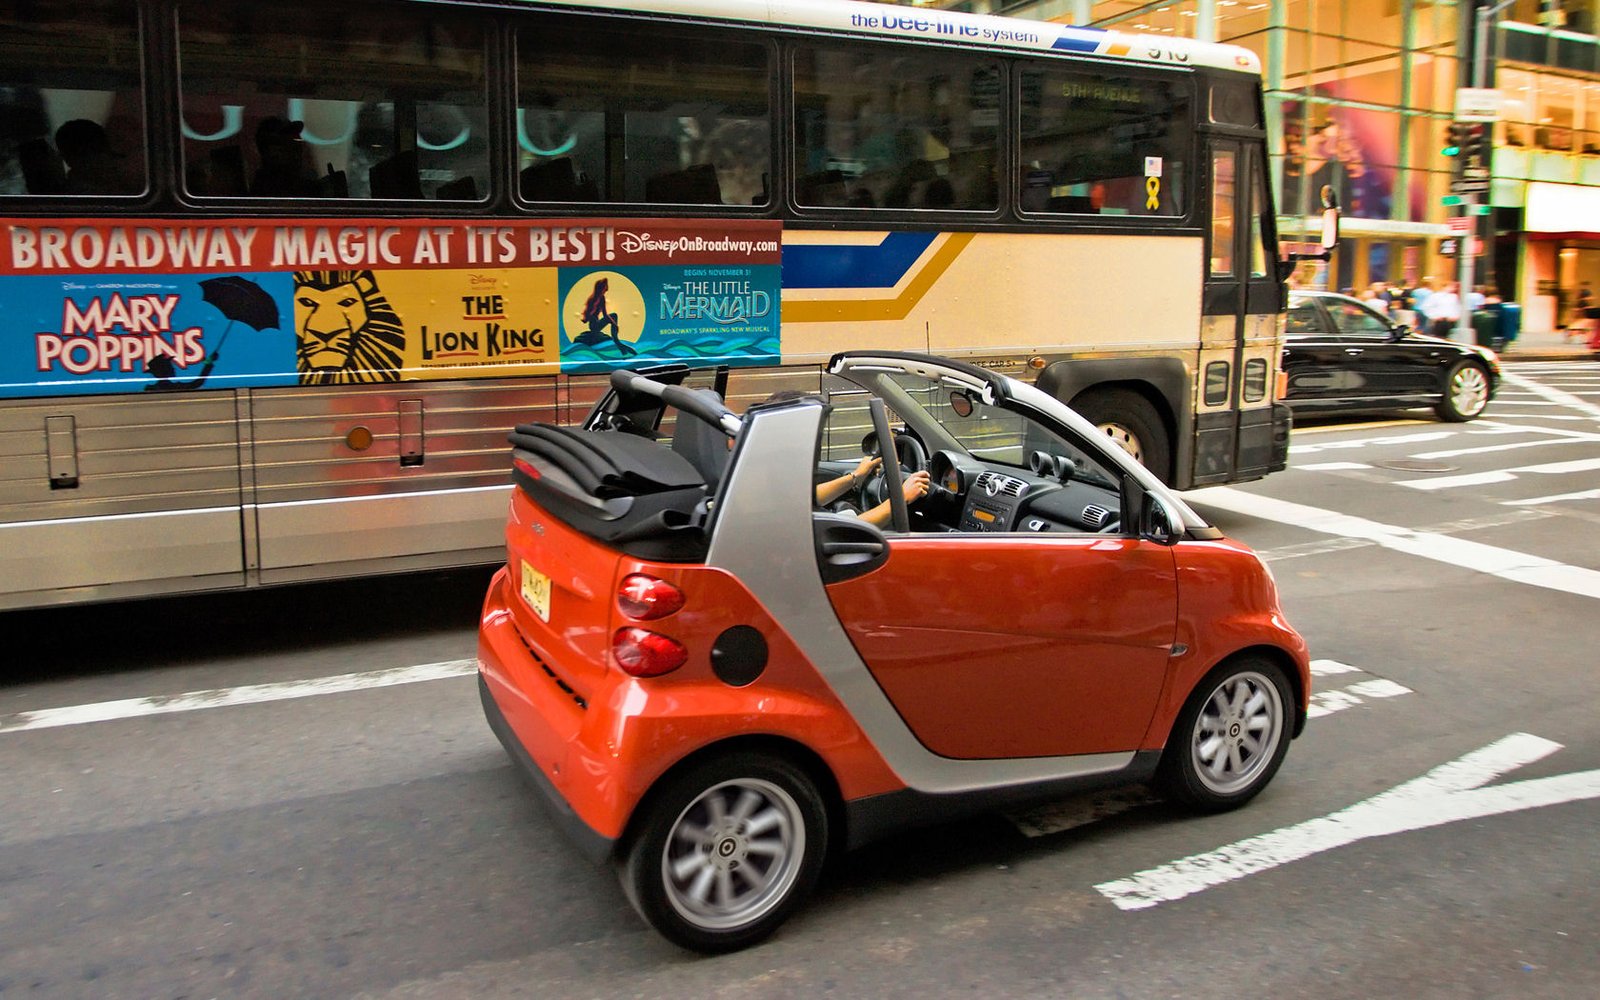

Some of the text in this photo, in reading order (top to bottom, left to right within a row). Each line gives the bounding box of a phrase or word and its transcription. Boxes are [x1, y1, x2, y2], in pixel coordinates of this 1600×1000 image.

[851, 14, 878, 28] the
[983, 28, 1039, 44] system
[11, 226, 616, 269] BROADWAY MAGIC AT ITS BEST!
[462, 295, 504, 315] THE
[683, 281, 751, 295] THE LITTLE
[62, 292, 179, 336] MARY
[660, 290, 771, 325] MERMAID
[35, 327, 206, 375] POPPINS
[421, 323, 544, 360] LION KING
